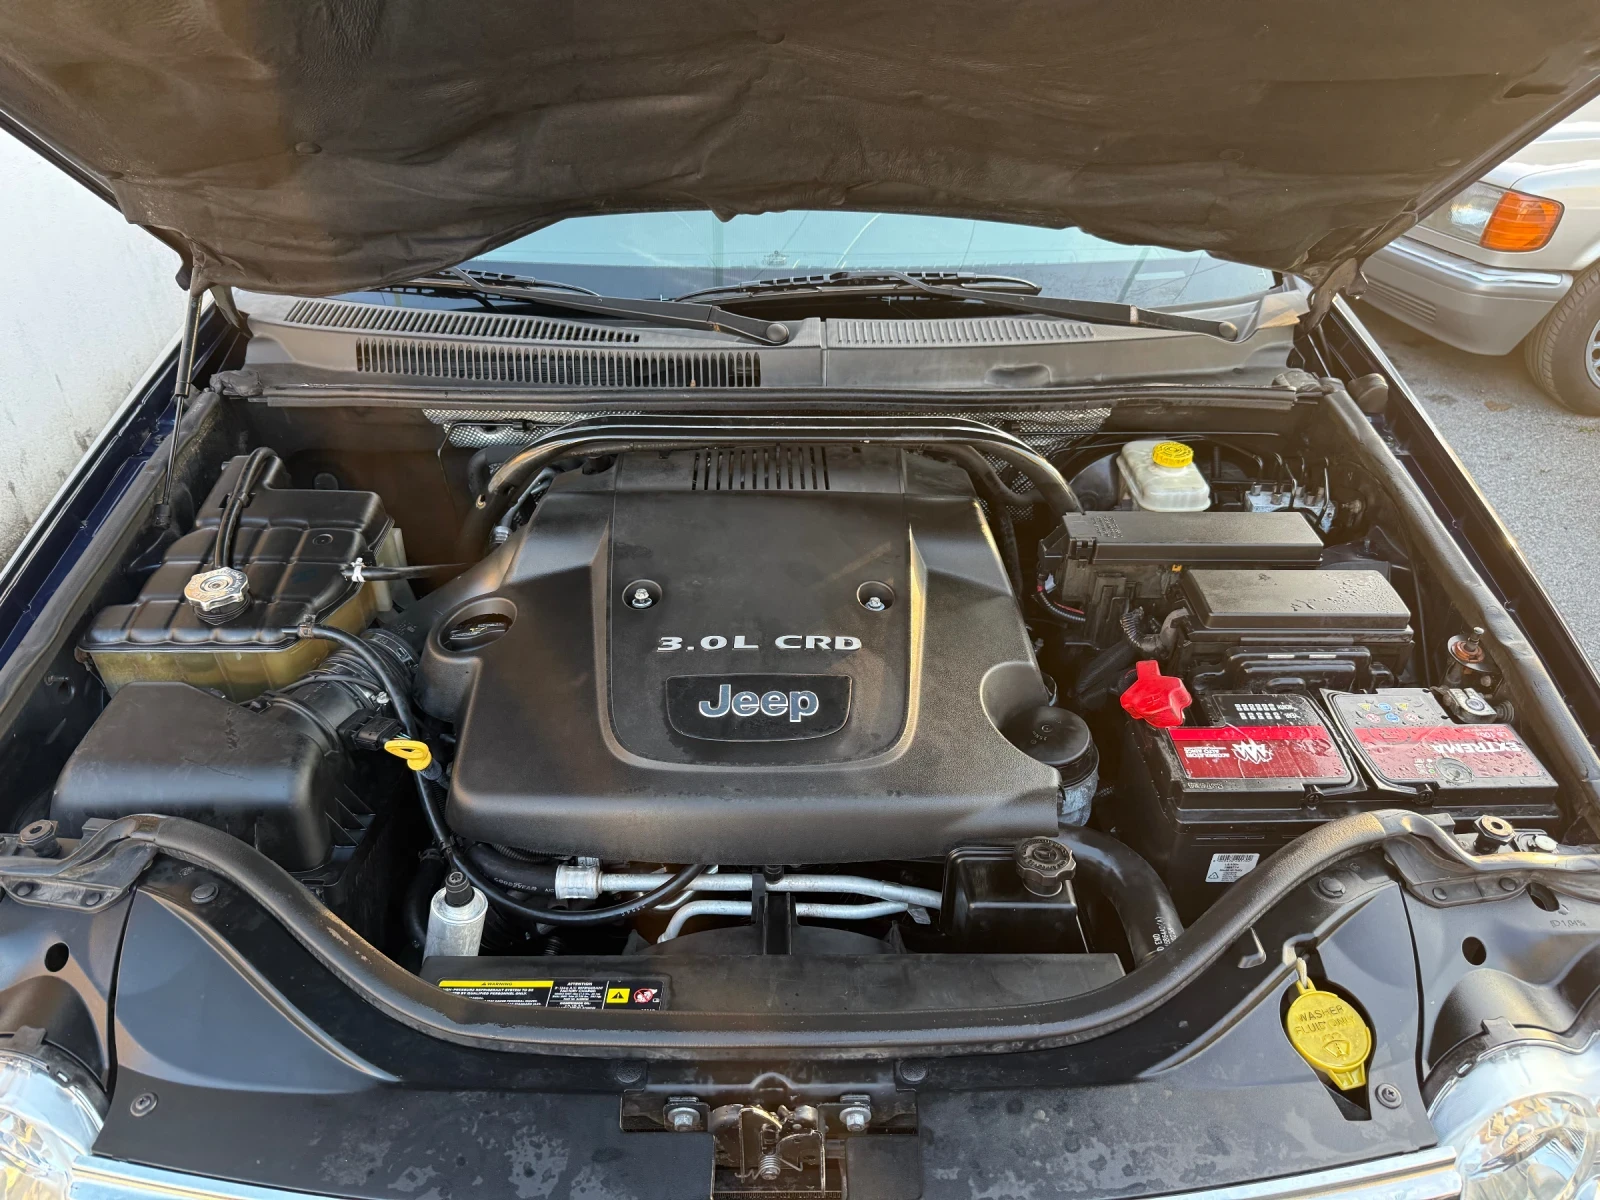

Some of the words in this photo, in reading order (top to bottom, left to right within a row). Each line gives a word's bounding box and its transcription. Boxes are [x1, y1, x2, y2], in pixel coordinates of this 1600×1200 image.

[657, 635, 759, 652] 3.0L
[774, 634, 863, 651] CRD
[698, 684, 819, 722] Jeep
[1430, 741, 1522, 754] EXTREMA
[1299, 1005, 1345, 1022] WASHER
[1294, 1021, 1326, 1036] FLUID
[1327, 1015, 1355, 1029] ONLY
